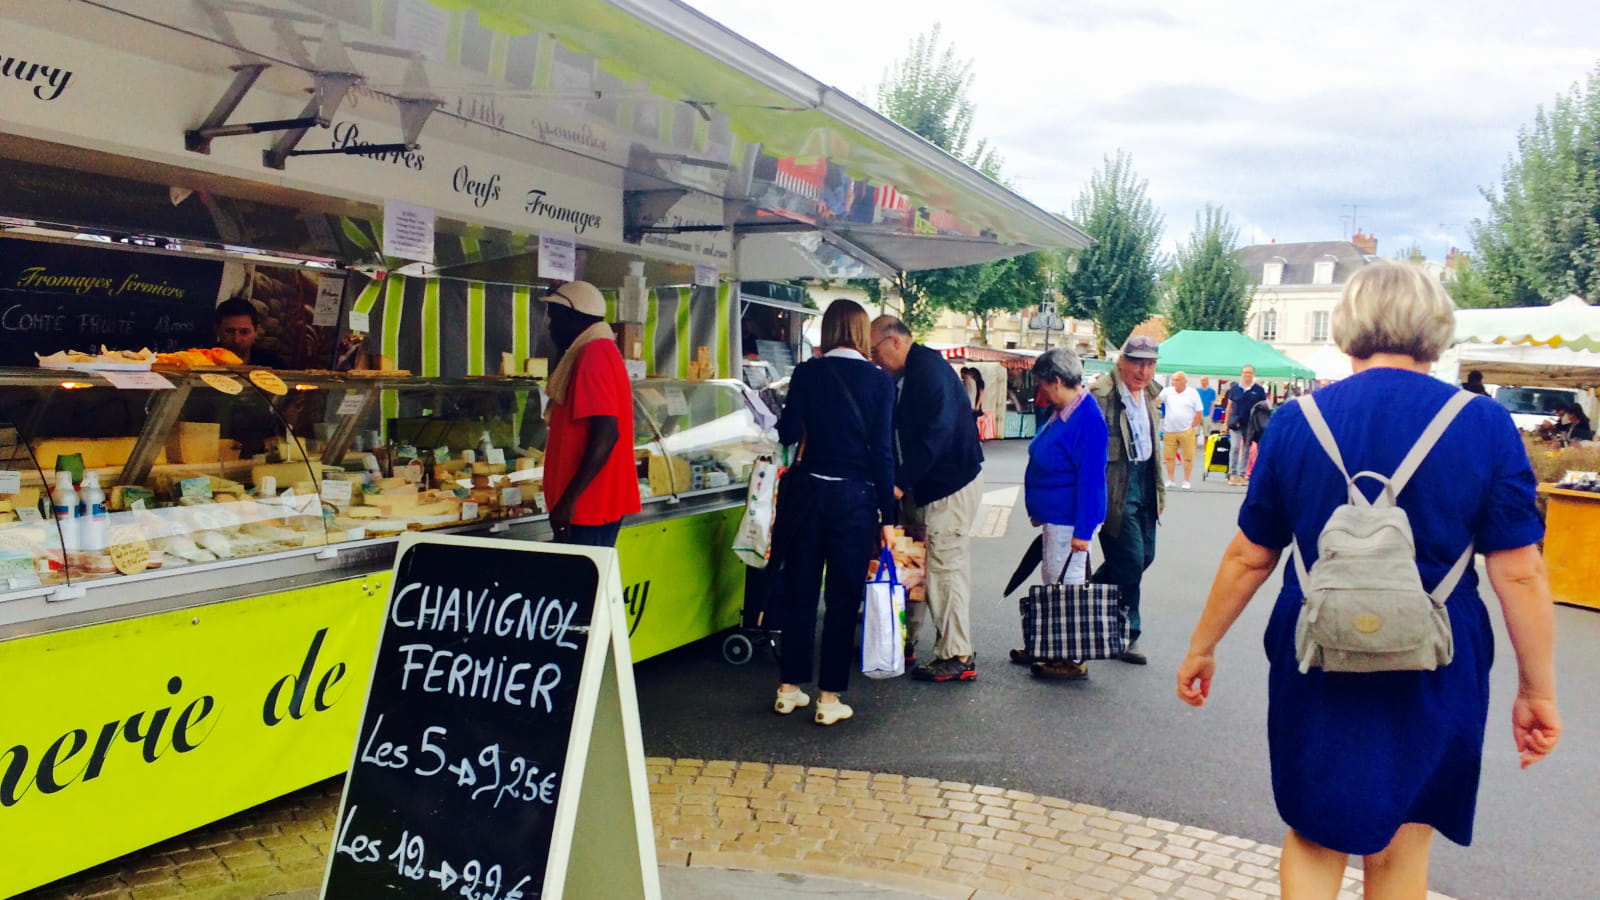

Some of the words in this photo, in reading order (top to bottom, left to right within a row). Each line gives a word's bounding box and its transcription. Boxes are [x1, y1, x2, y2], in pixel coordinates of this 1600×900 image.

[0, 55, 73, 101] ury
[453, 164, 501, 208] Oeufs
[525, 189, 602, 234] Fromages
[17, 267, 112, 296] Fromages
[109, 273, 187, 299] fermiers
[262, 627, 353, 727] de
[361, 714, 408, 769] Les
[414, 726, 447, 777] 5
[336, 805, 382, 863] Les
[388, 830, 425, 880] 12
